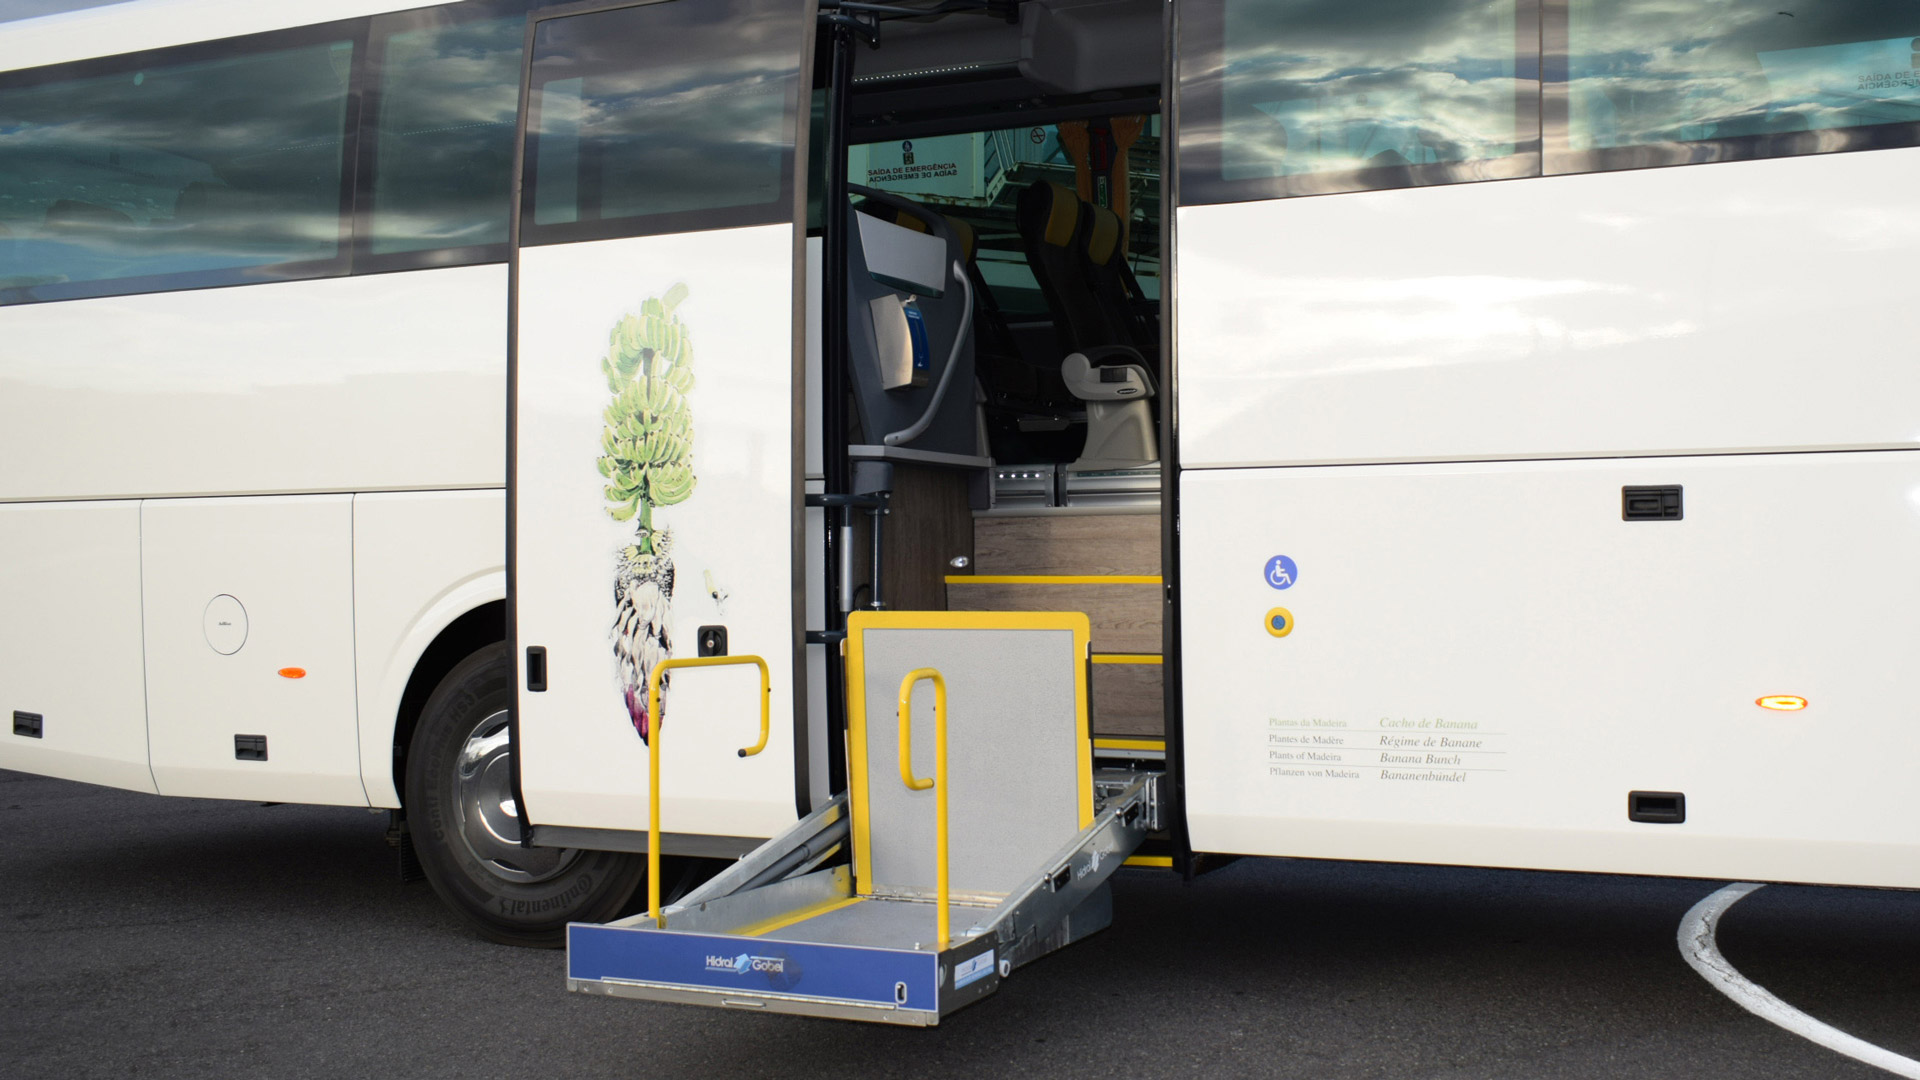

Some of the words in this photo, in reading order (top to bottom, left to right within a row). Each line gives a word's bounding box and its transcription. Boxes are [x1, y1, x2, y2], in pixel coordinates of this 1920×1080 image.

[868, 168, 891, 176] SAÍDA
[905, 163, 957, 172] EMERGÊNCIA
[1269, 717, 1298, 727] Plantas
[1300, 719, 1310, 727] da
[1312, 719, 1347, 728] Madeira
[1379, 717, 1415, 728] Cacho
[1417, 718, 1432, 728] de
[1435, 718, 1478, 729] Banana
[1269, 734, 1298, 743] Plantes
[1300, 735, 1310, 744] de
[1312, 736, 1344, 745] Madère
[1379, 735, 1420, 748] Régime
[1423, 736, 1437, 747] de
[1440, 737, 1482, 748] Banane
[1269, 750, 1294, 760] Plants
[1296, 752, 1305, 760] of
[1307, 752, 1342, 761] Madeira
[1380, 752, 1422, 764] Banana
[1425, 753, 1461, 765] Bunch
[1269, 767, 1305, 776] Pflanzen
[1325, 769, 1360, 779] Madeira
[509, 872, 594, 916] Continental
[706, 955, 734, 968] Hidral
[752, 959, 784, 973] Gobel
